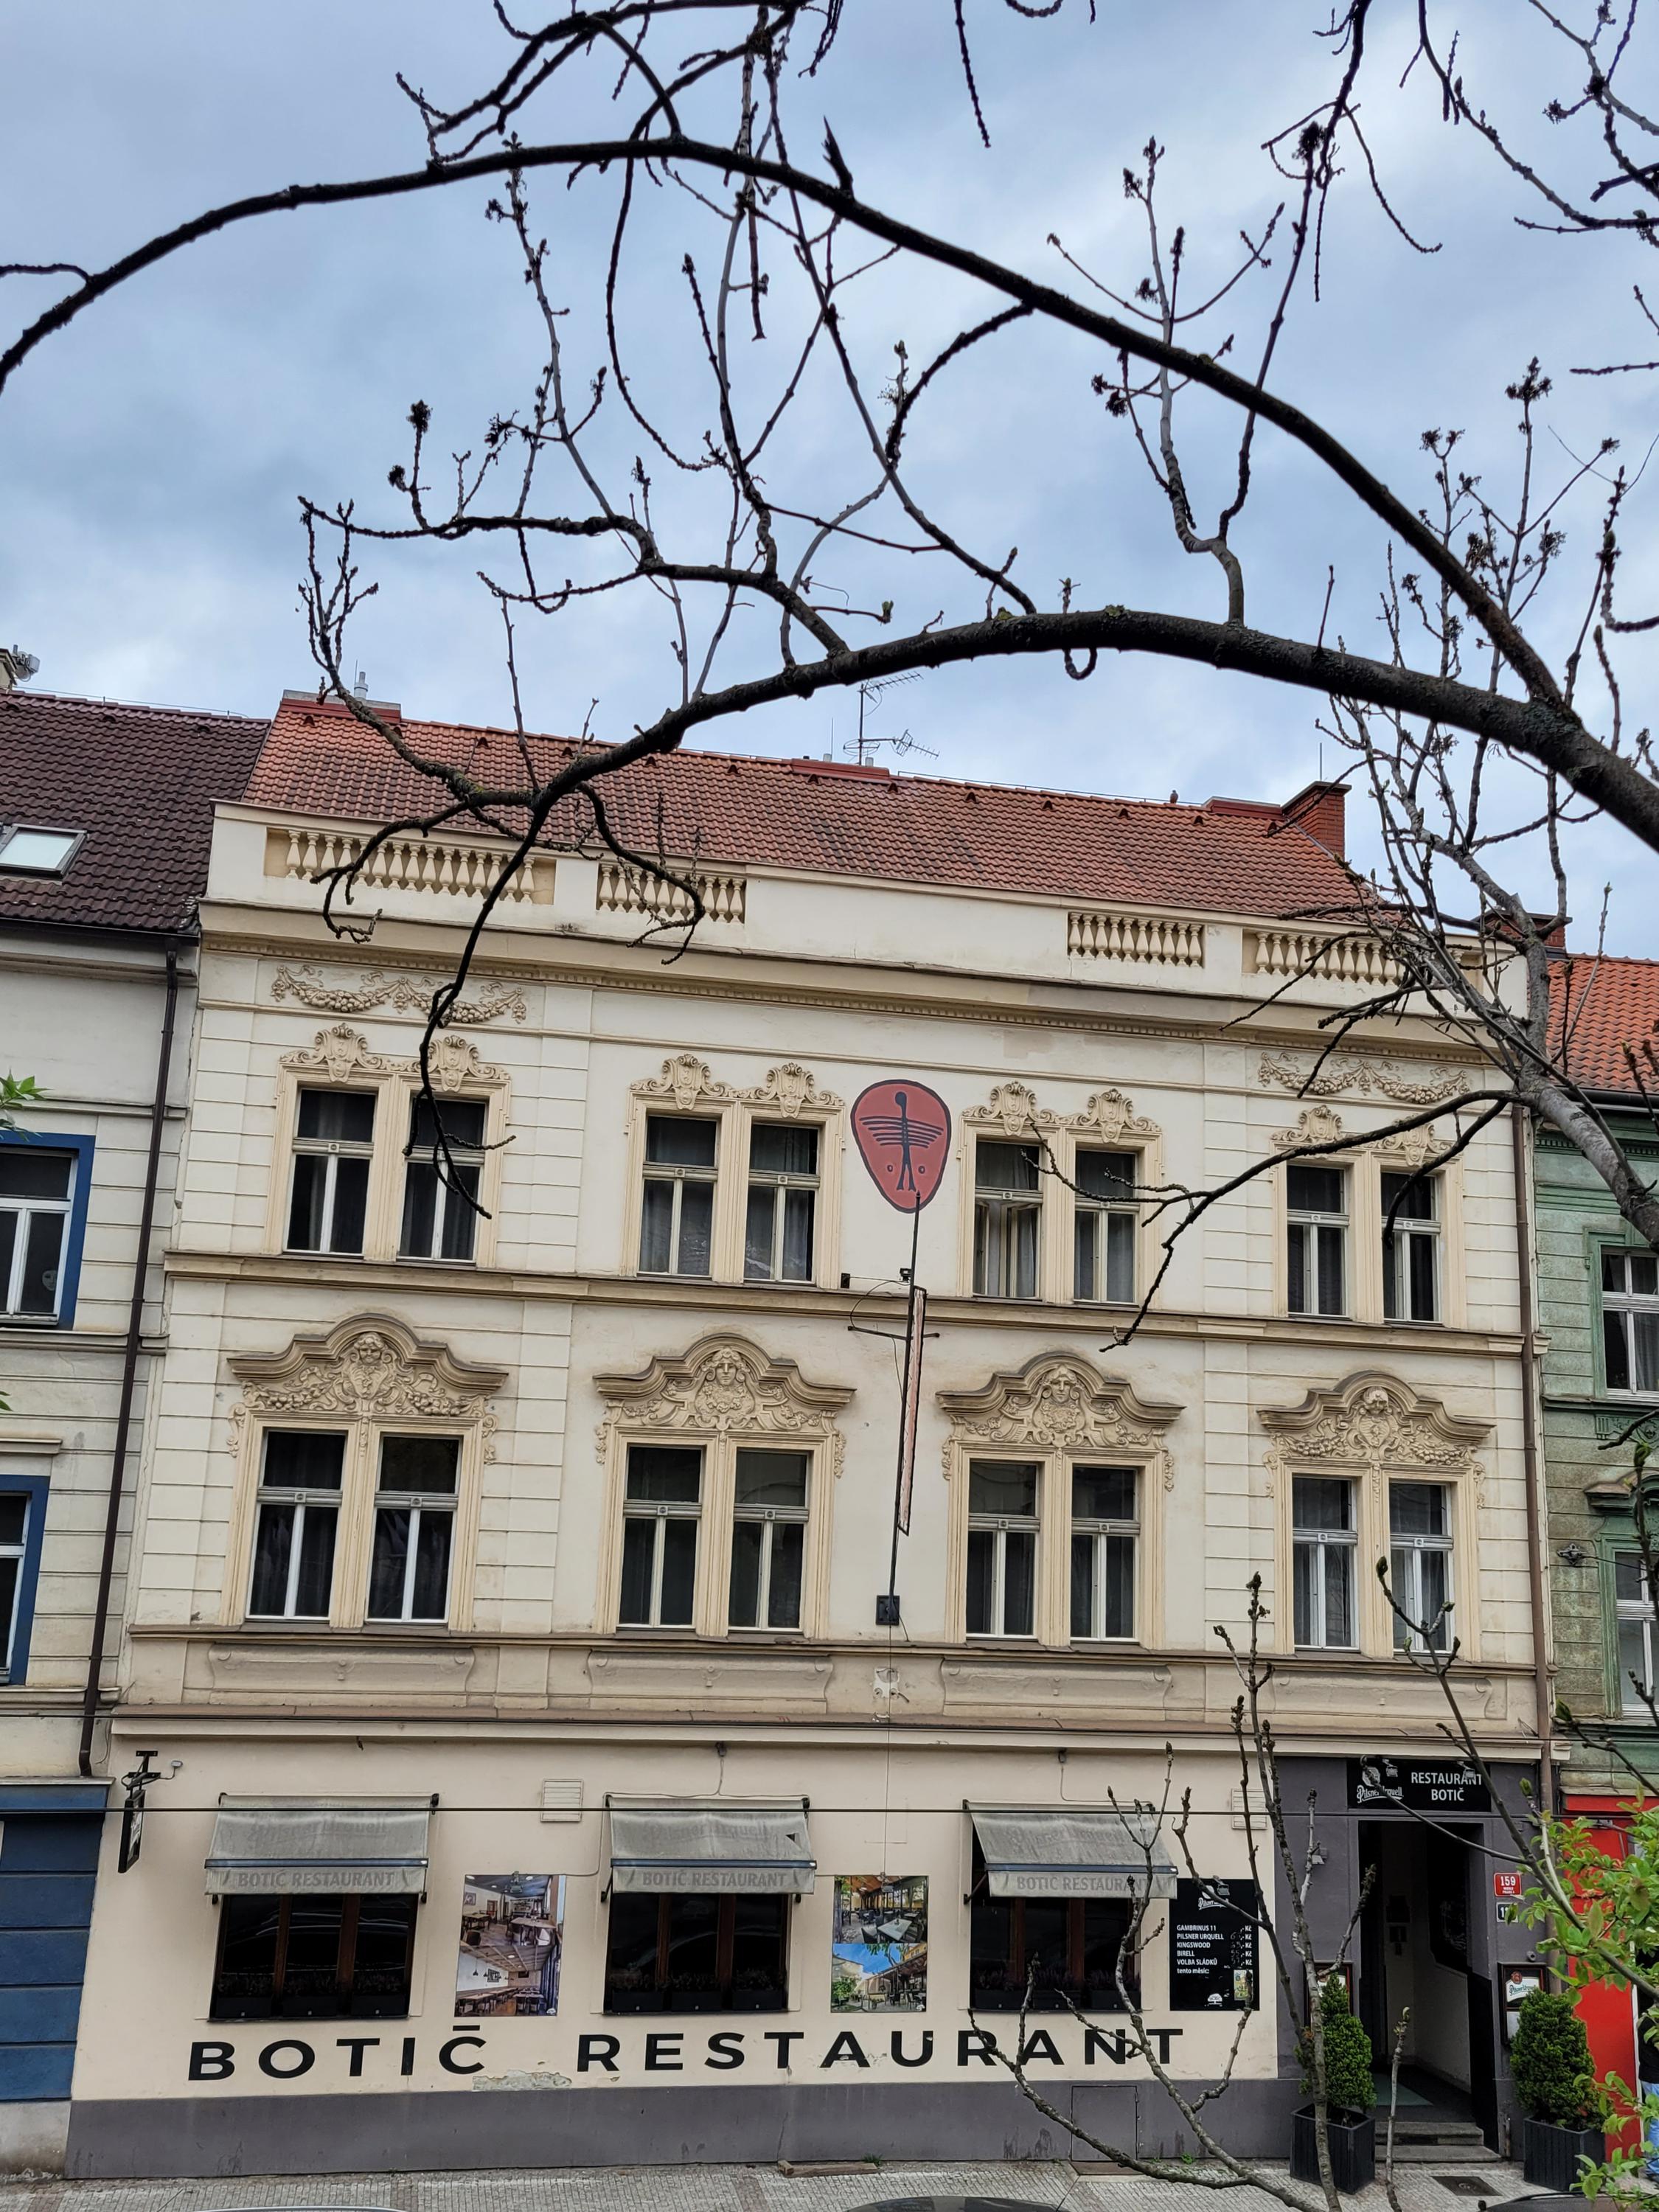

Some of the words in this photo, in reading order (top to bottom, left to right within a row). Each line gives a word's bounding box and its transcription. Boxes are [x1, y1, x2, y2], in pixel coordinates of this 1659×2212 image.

[1411, 1772, 1482, 1785] RESTAURANT
[1357, 1785, 1380, 1804] Pilsne
[1431, 1787, 1464, 1801] BOTIČ
[291, 1872, 395, 1887] RESTAURANT
[692, 1872, 787, 1888] RESTAURANT
[1500, 1876, 1516, 1886] 159
[1196, 1958, 1217, 1966] SLÁDKŮ
[577, 2028, 1183, 2073] RESTAURANT
